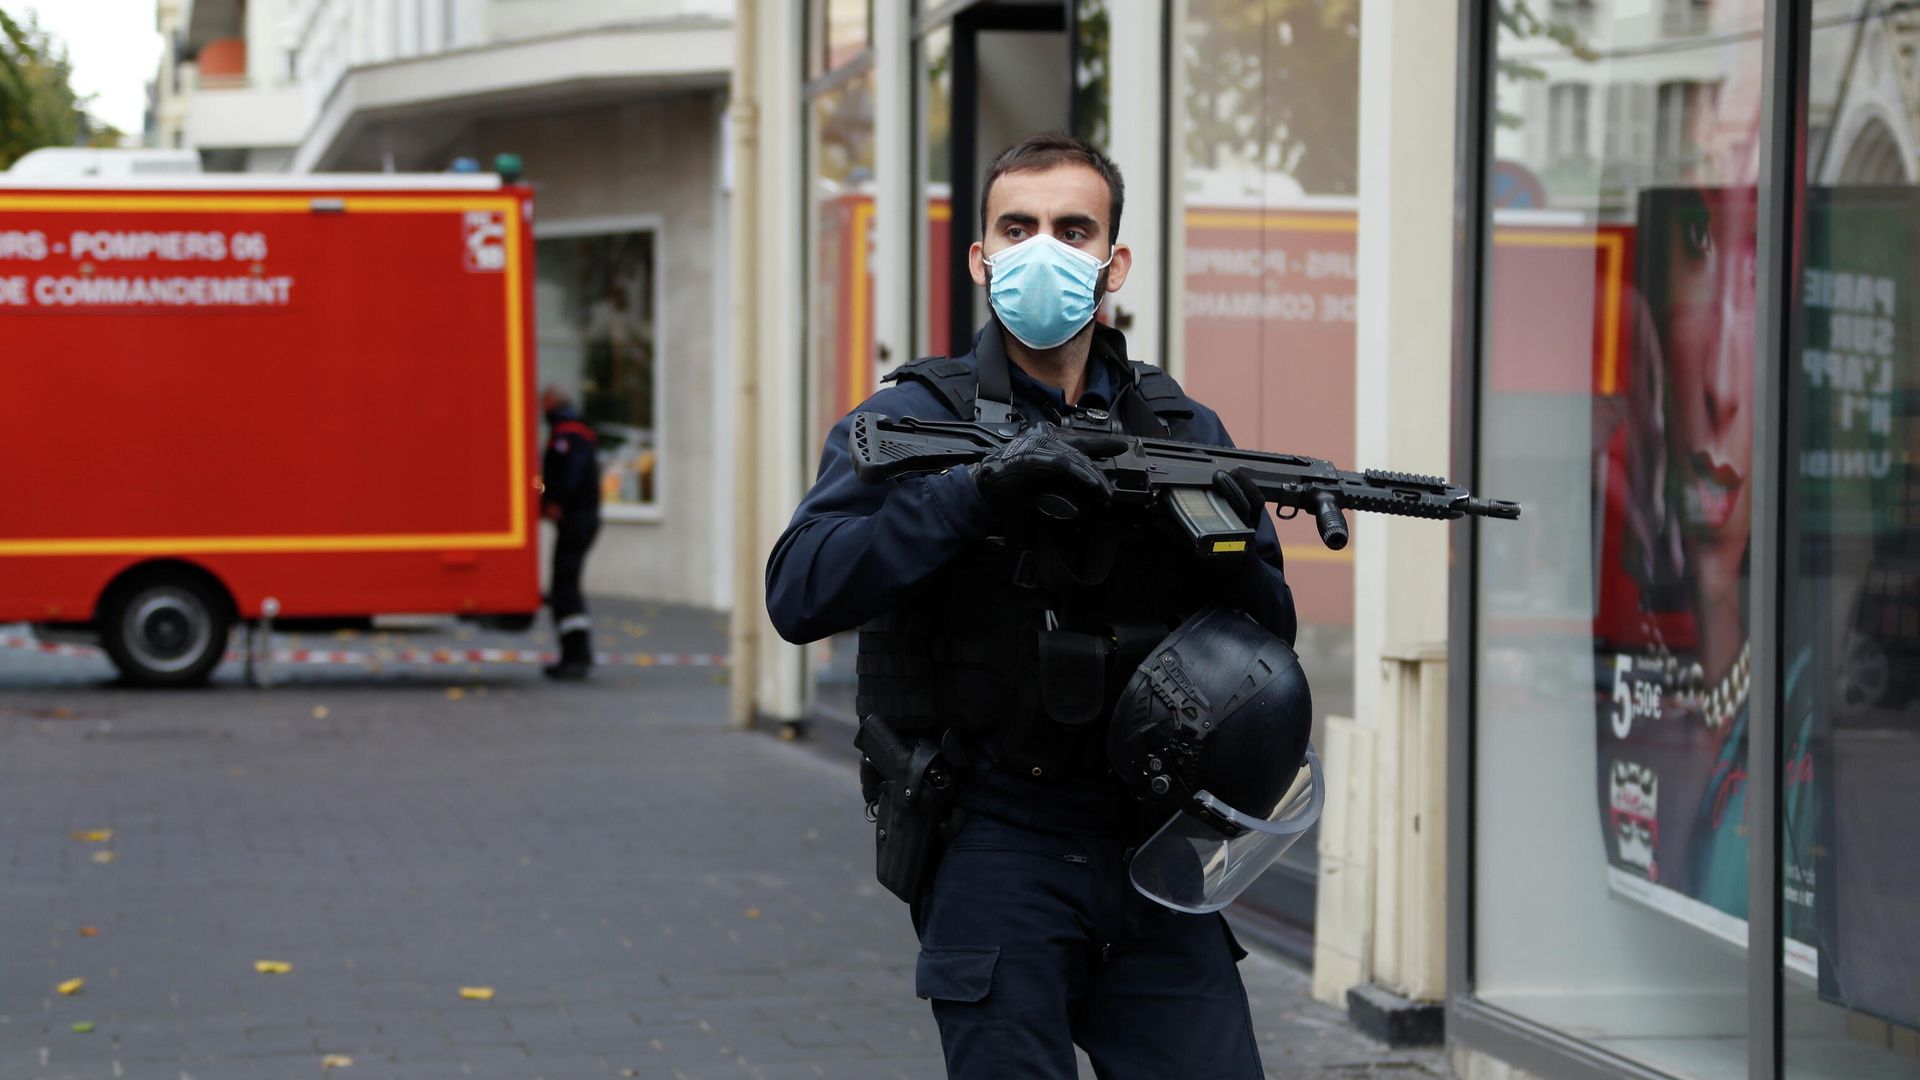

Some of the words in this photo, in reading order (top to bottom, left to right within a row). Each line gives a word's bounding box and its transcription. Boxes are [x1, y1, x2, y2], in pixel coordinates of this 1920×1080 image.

[70, 230, 227, 261] POMPIERS
[230, 231, 267, 261] 06
[34, 275, 292, 305] COMMANDEMENT
